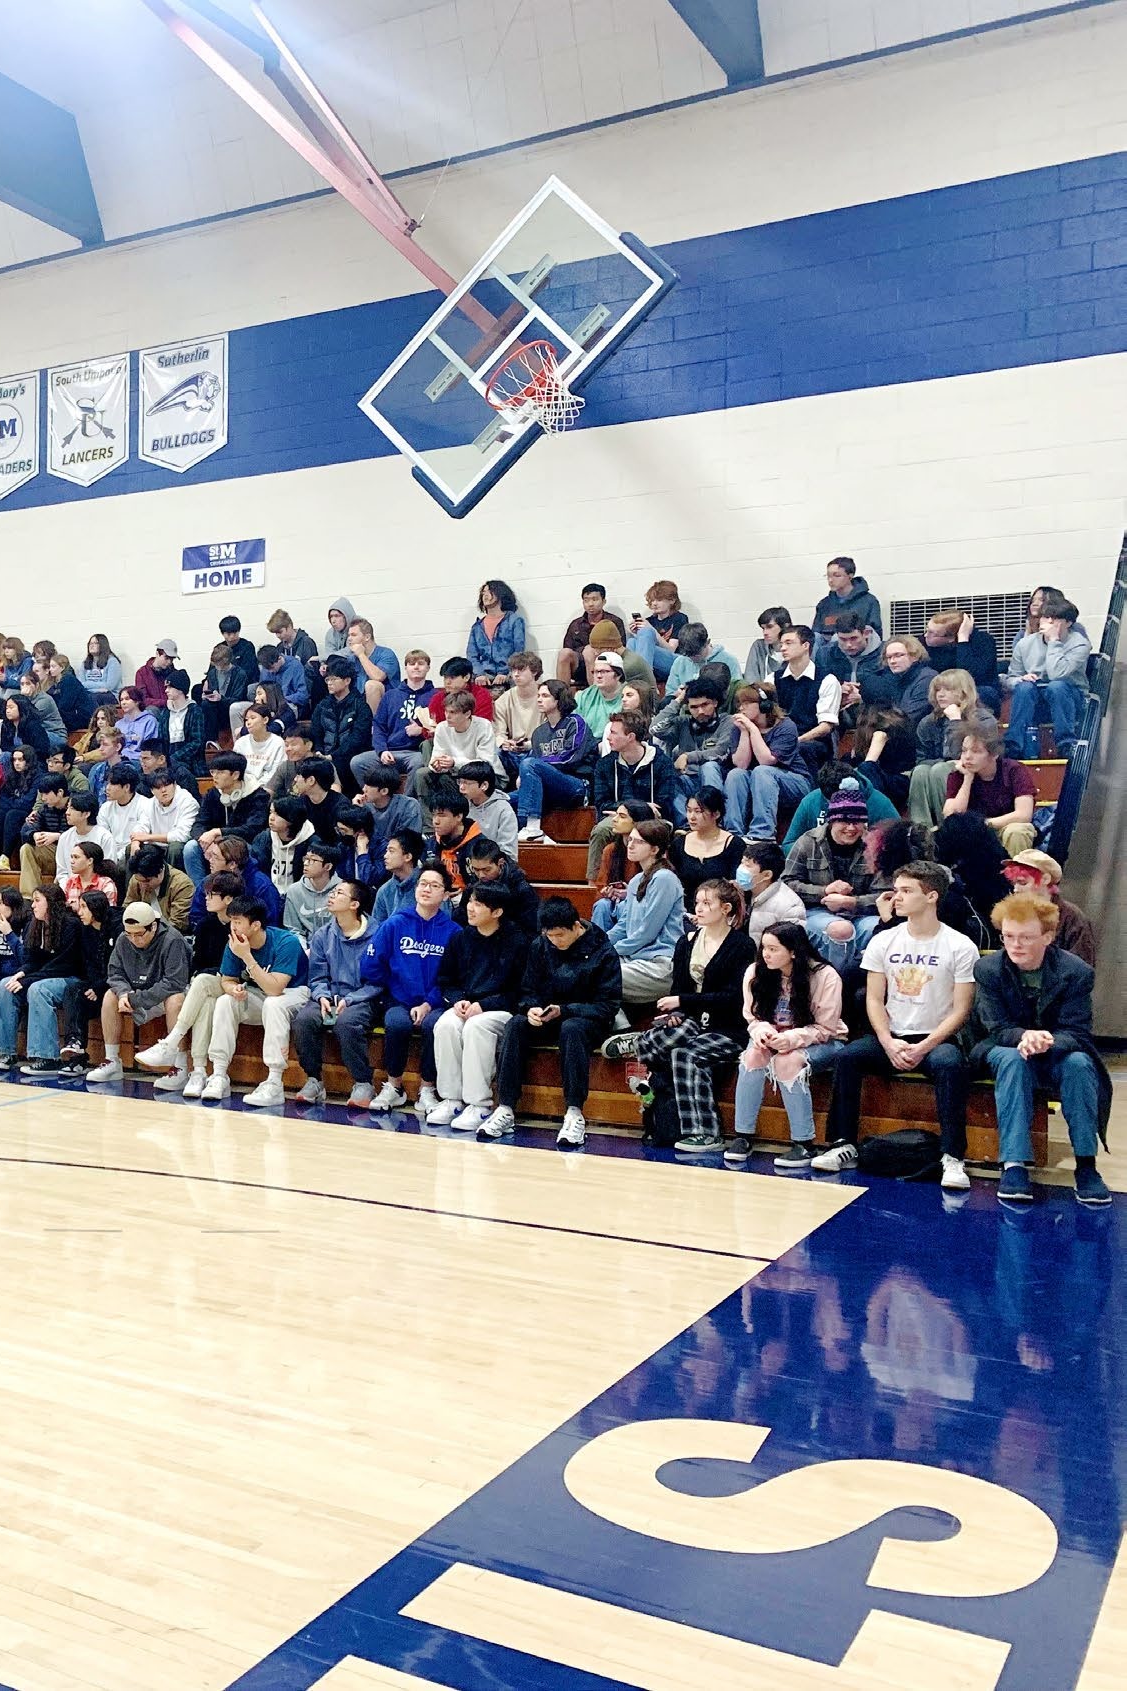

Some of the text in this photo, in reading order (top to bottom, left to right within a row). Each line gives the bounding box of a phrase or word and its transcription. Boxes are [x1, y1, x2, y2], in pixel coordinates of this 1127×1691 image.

[158, 346, 210, 368] Sutherlin
[56, 373, 81, 386] South
[151, 429, 215, 453] BULLDOGS
[62, 447, 114, 466] LANCERS
[194, 568, 252, 588] HOME
[400, 936, 445, 959] Dodgers
[889, 953, 940, 967] CAKE
